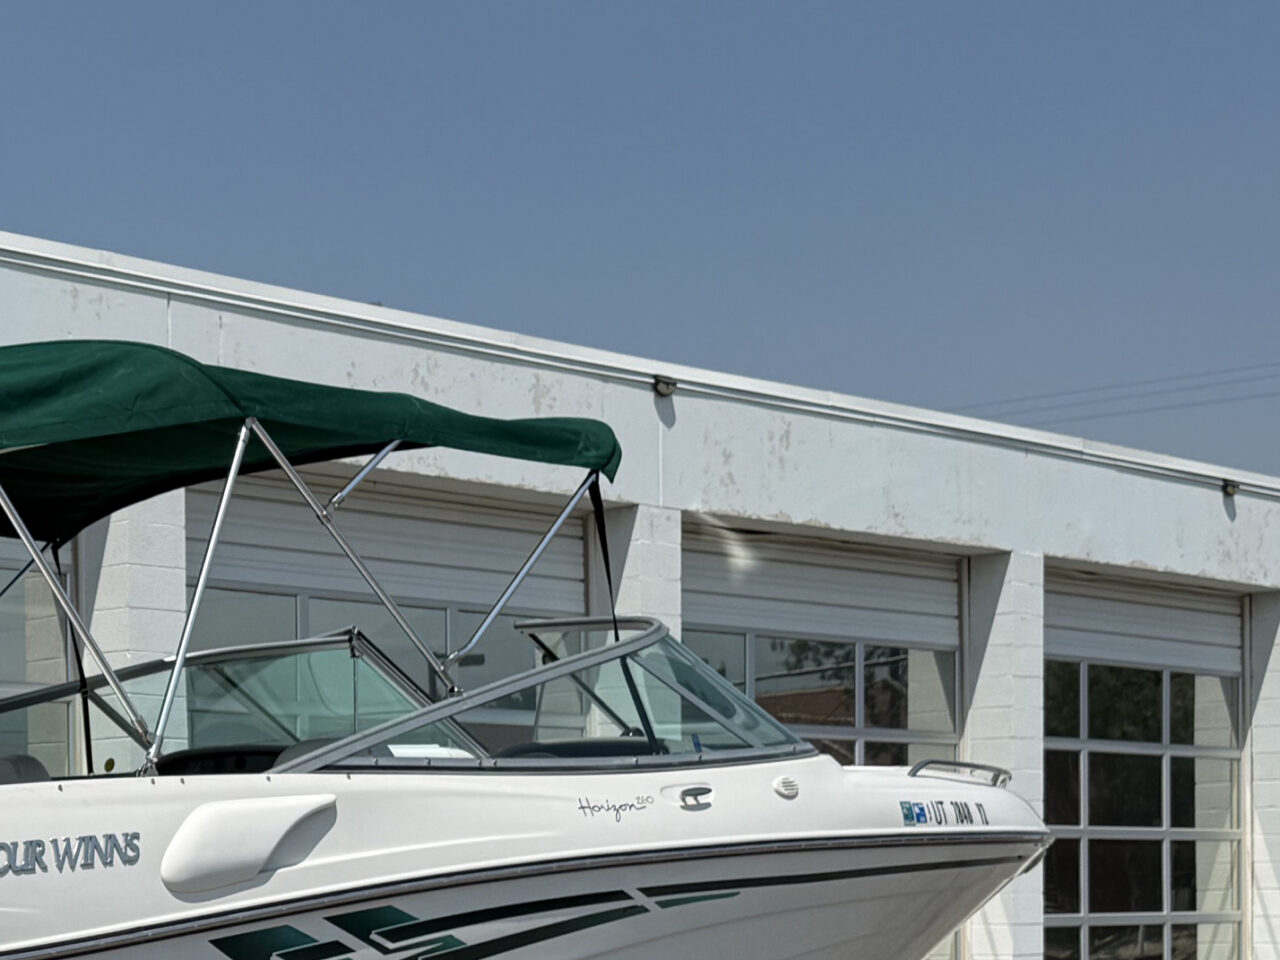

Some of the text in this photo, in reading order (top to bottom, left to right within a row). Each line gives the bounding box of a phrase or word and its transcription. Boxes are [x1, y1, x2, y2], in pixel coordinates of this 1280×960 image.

[578, 796, 647, 822] Horizon
[930, 800, 948, 825] UT
[49, 832, 141, 874] WINNS
